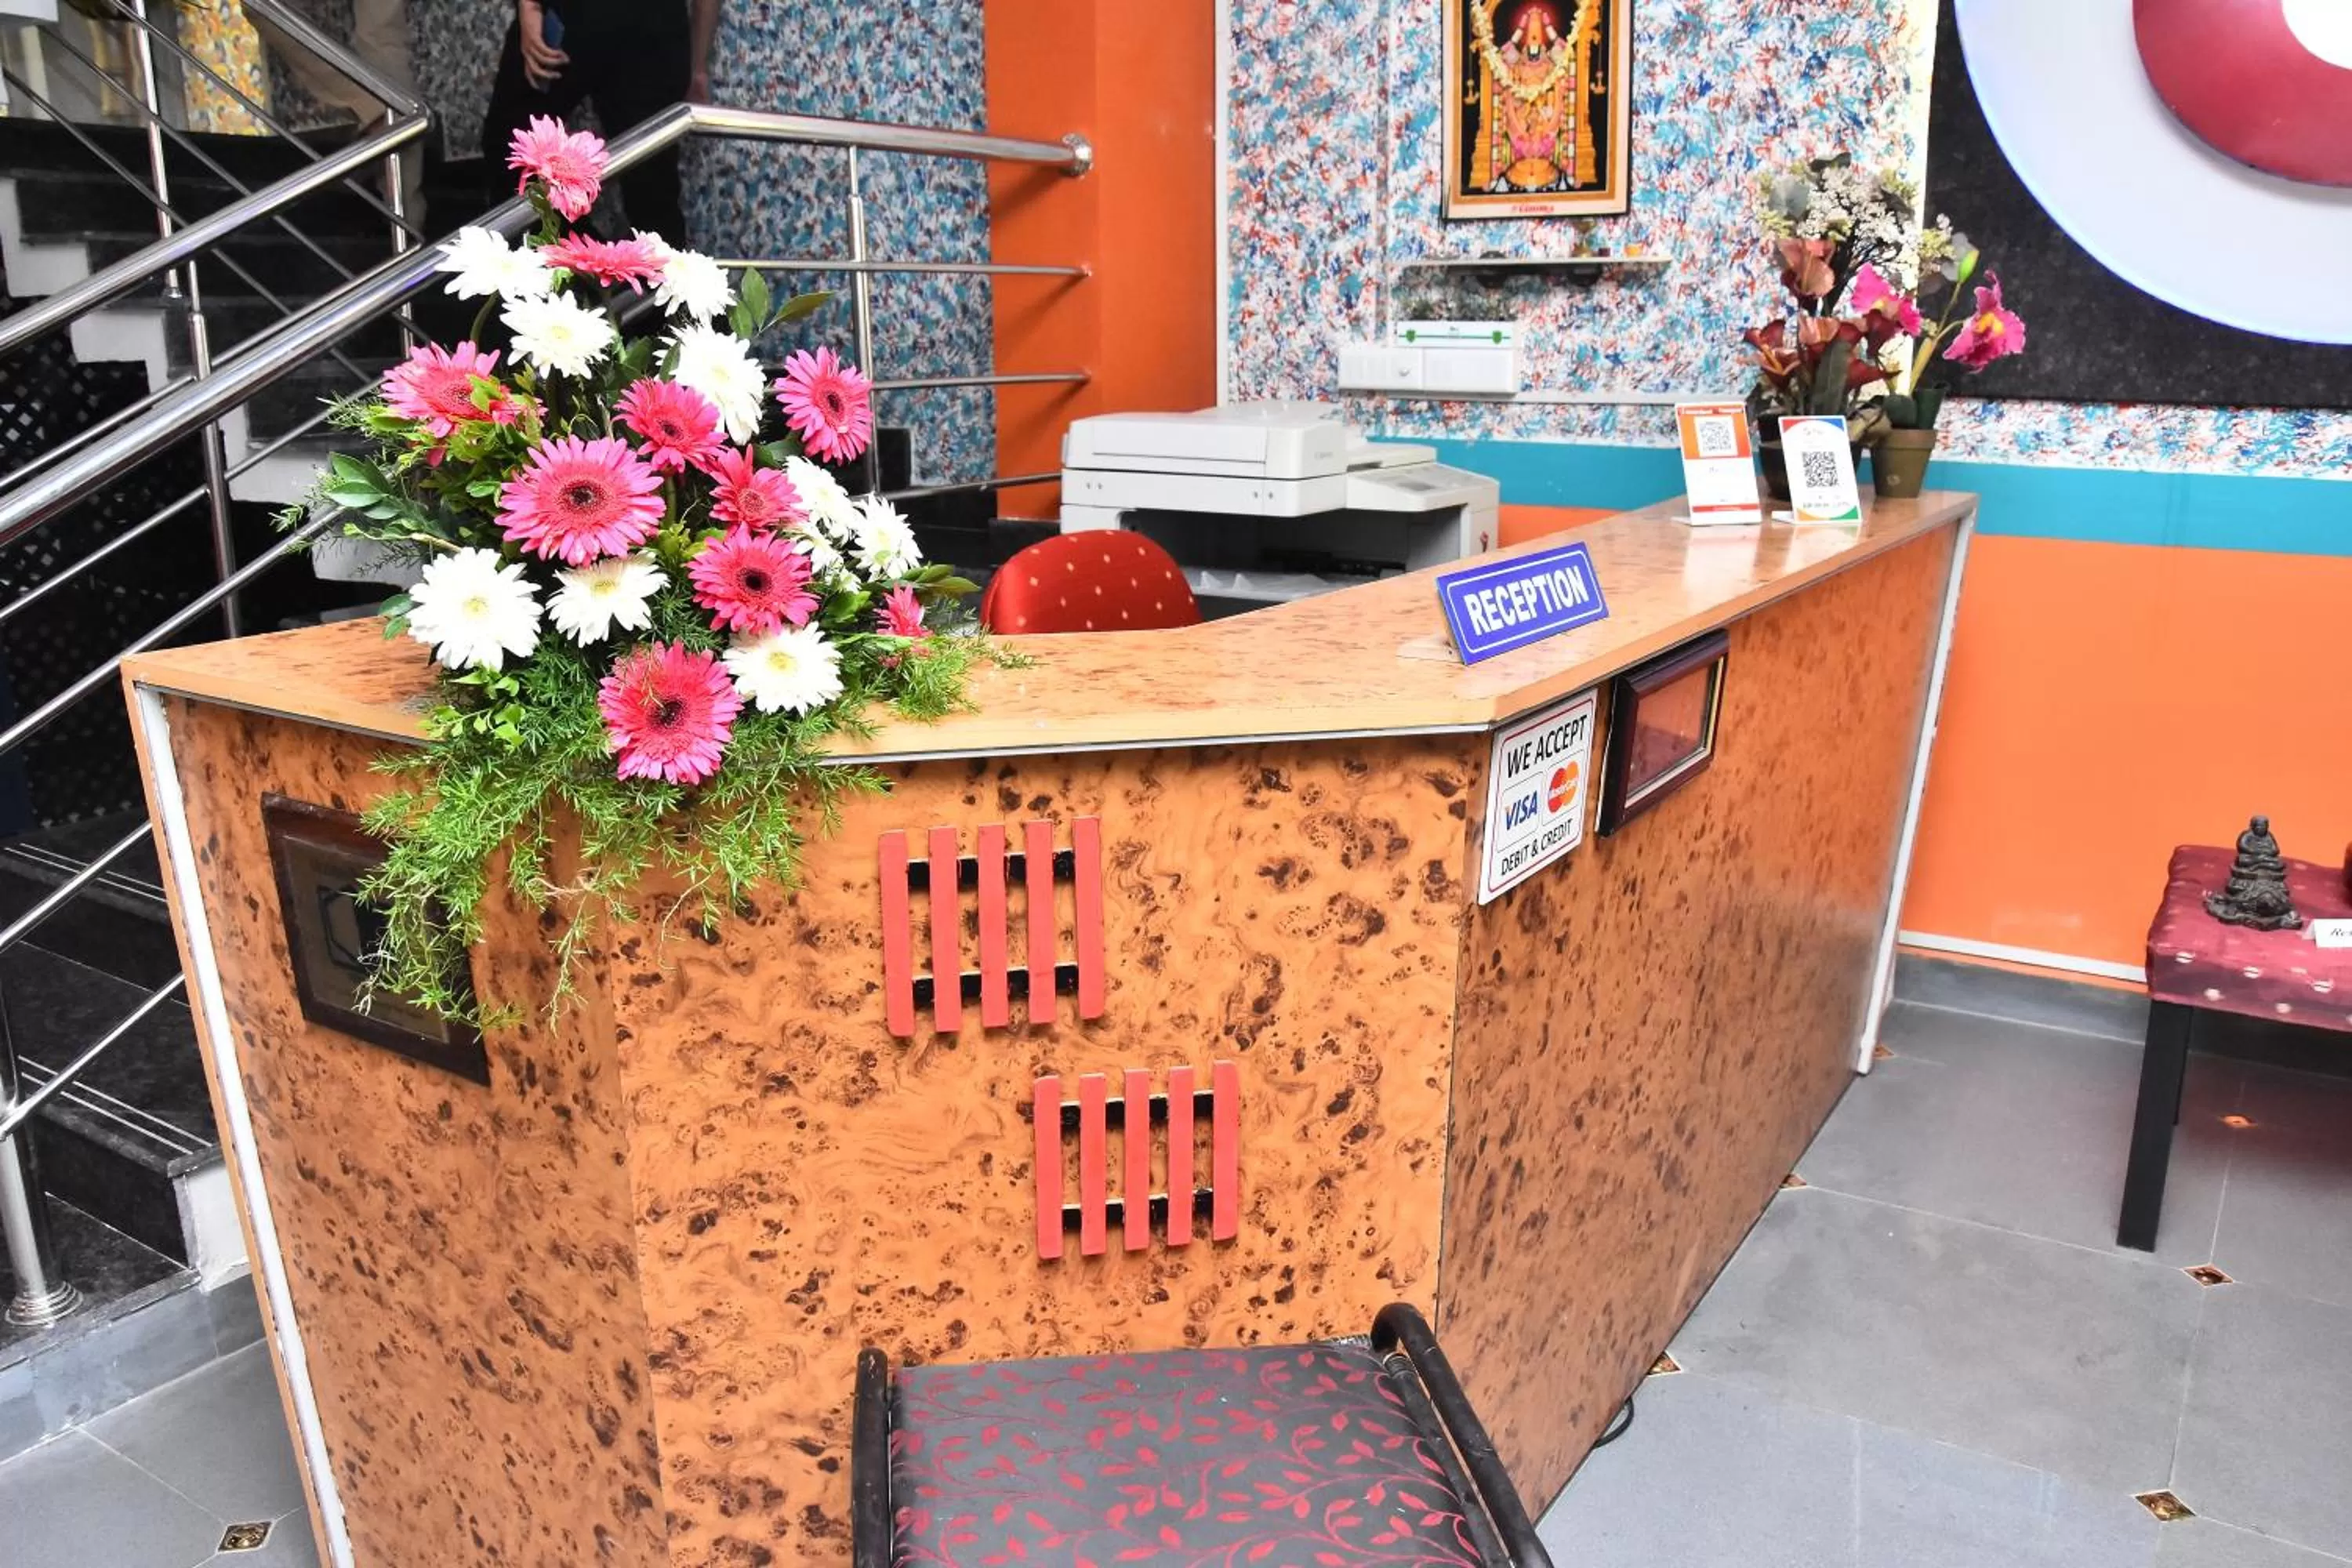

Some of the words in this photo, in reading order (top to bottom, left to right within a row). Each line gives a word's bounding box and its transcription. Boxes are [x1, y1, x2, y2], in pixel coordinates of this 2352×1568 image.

[1465, 566, 1589, 636] RECEPTION
[1508, 742, 1533, 778] WE
[1535, 714, 1588, 764] ACCEPT
[1504, 790, 1537, 830] VISA
[1501, 844, 1530, 876] DEBIT
[1531, 839, 1539, 857] &
[1541, 818, 1572, 851] CREDIT
